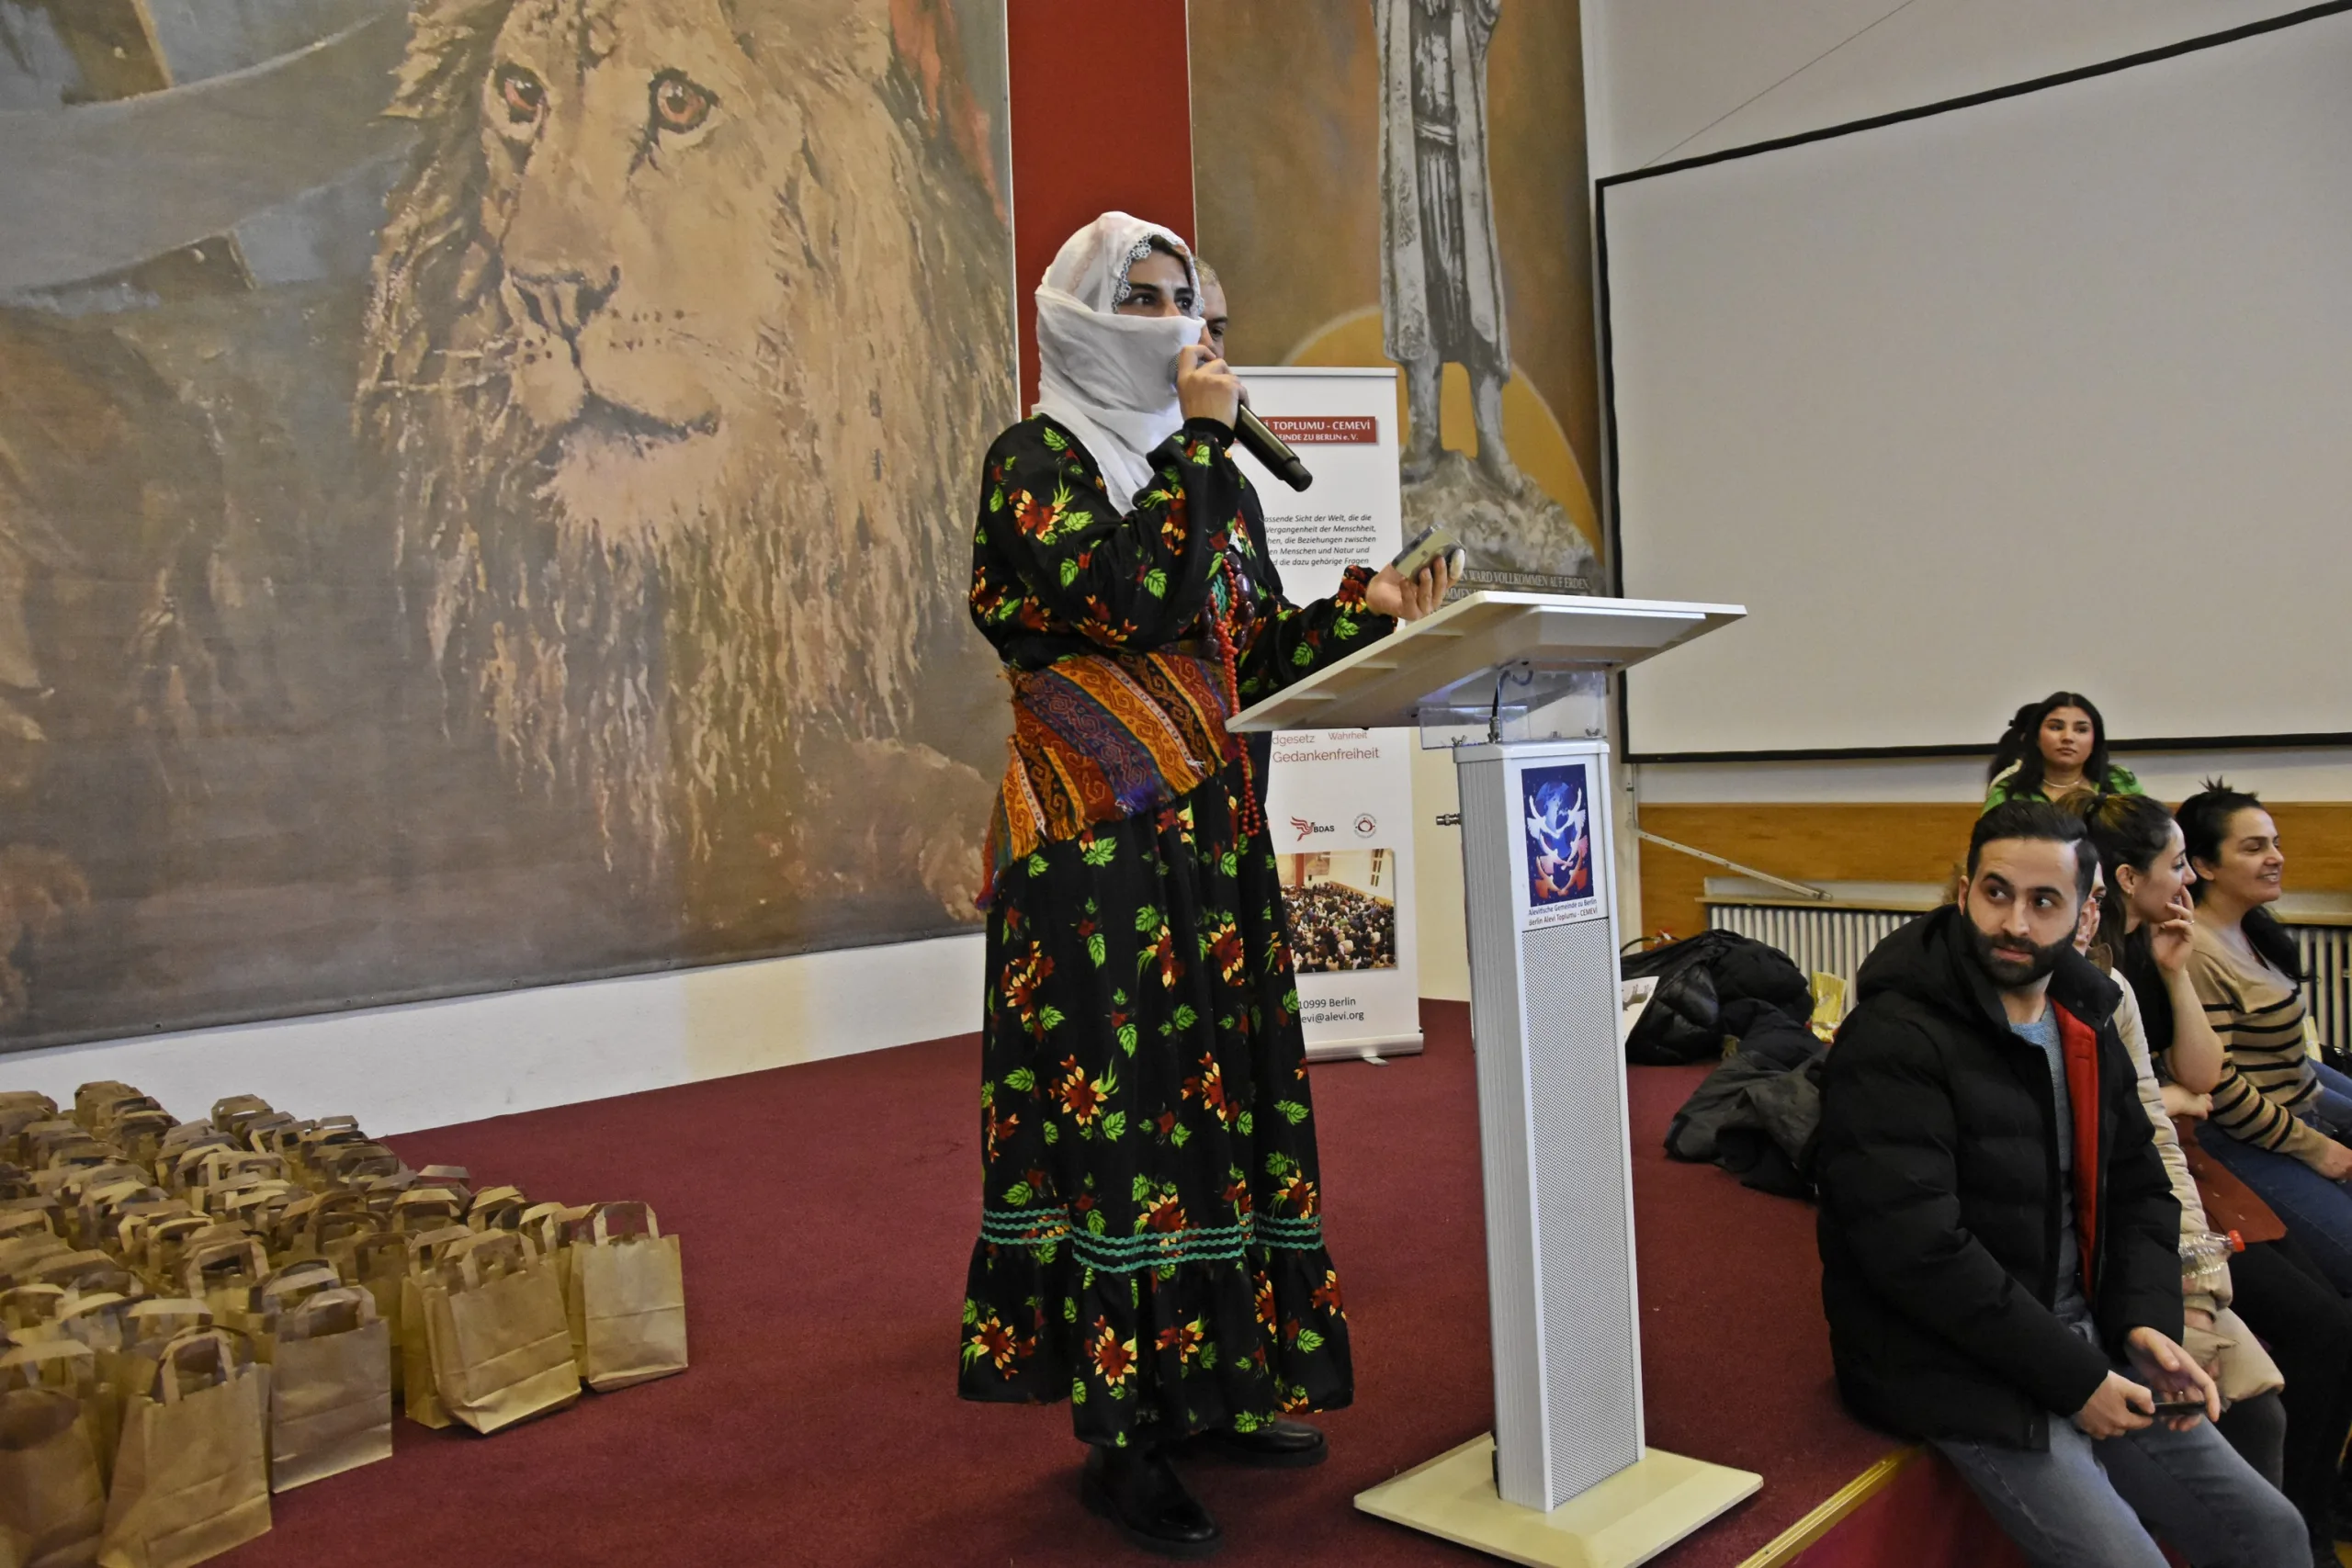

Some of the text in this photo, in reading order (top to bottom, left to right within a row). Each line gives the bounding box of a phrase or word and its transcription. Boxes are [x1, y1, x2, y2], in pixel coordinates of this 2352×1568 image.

[1272, 421, 1325, 430] TOPLUMU
[1332, 420, 1371, 431] CEMEVİ
[1295, 514, 1313, 523] Sicht
[1328, 514, 1346, 523] Welt,
[1333, 525, 1376, 533] Menschheit,
[1297, 536, 1342, 545] Beziehungen
[1311, 558, 1342, 567] gehörige
[1328, 731, 1367, 740] Wahrheit
[1272, 734, 1316, 747] dgesetz
[1272, 747, 1380, 763] Gedankenfreiheit
[1313, 825, 1335, 833] BDAS
[1555, 902, 1577, 911] Gemeinde
[1529, 918, 1544, 926] Berlin
[1299, 997, 1356, 1010] 10999 Berlin
[1301, 1010, 1364, 1023] evi@alevi.org
